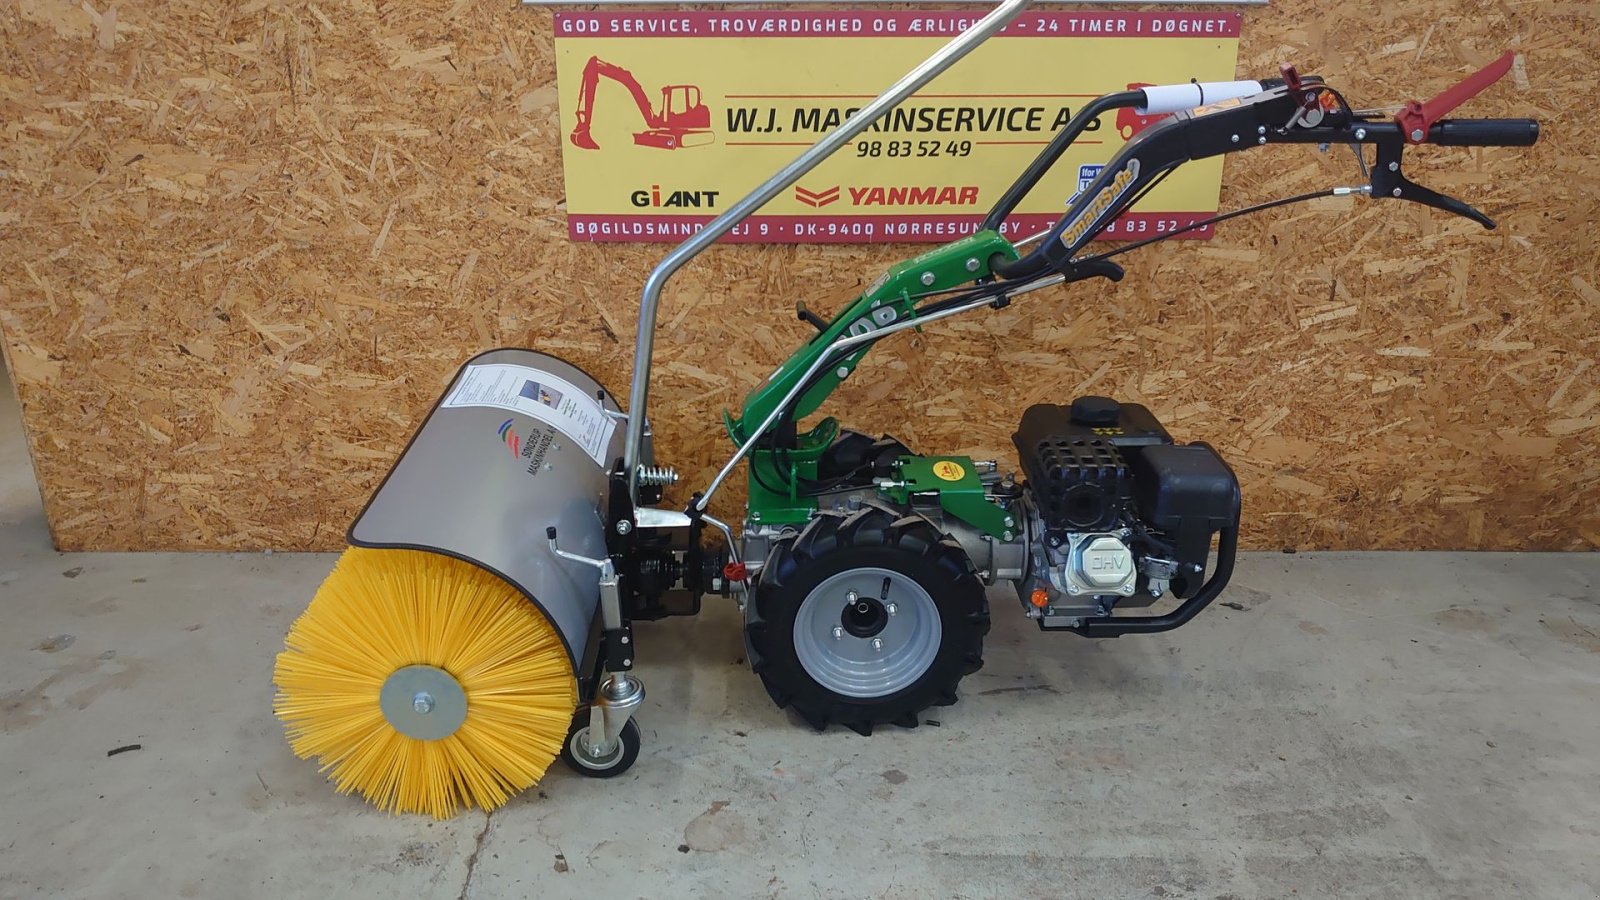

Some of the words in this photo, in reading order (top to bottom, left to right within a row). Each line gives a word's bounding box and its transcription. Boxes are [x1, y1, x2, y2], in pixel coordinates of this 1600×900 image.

[562, 19, 600, 33] GOD
[610, 19, 698, 34] SERVICE,
[708, 19, 862, 33] TROVÆRDIGHED
[873, 19, 897, 33] OG
[1037, 19, 1059, 33] 24
[1069, 19, 1127, 33] TIMER
[1137, 19, 1142, 33] I
[1152, 19, 1232, 33] DØGNET.
[727, 108, 783, 133] W.J.
[857, 140, 882, 158] 98
[887, 140, 912, 158] 83
[917, 140, 941, 157] 52
[946, 140, 972, 157] 49
[848, 186, 979, 206] YANMAR
[760, 223, 769, 235] 9
[795, 223, 874, 236] DK-9400
[885, 221, 1020, 236] NØRRESUNBY
[1126, 220, 1147, 232] 83
[1157, 220, 1178, 232] 52
